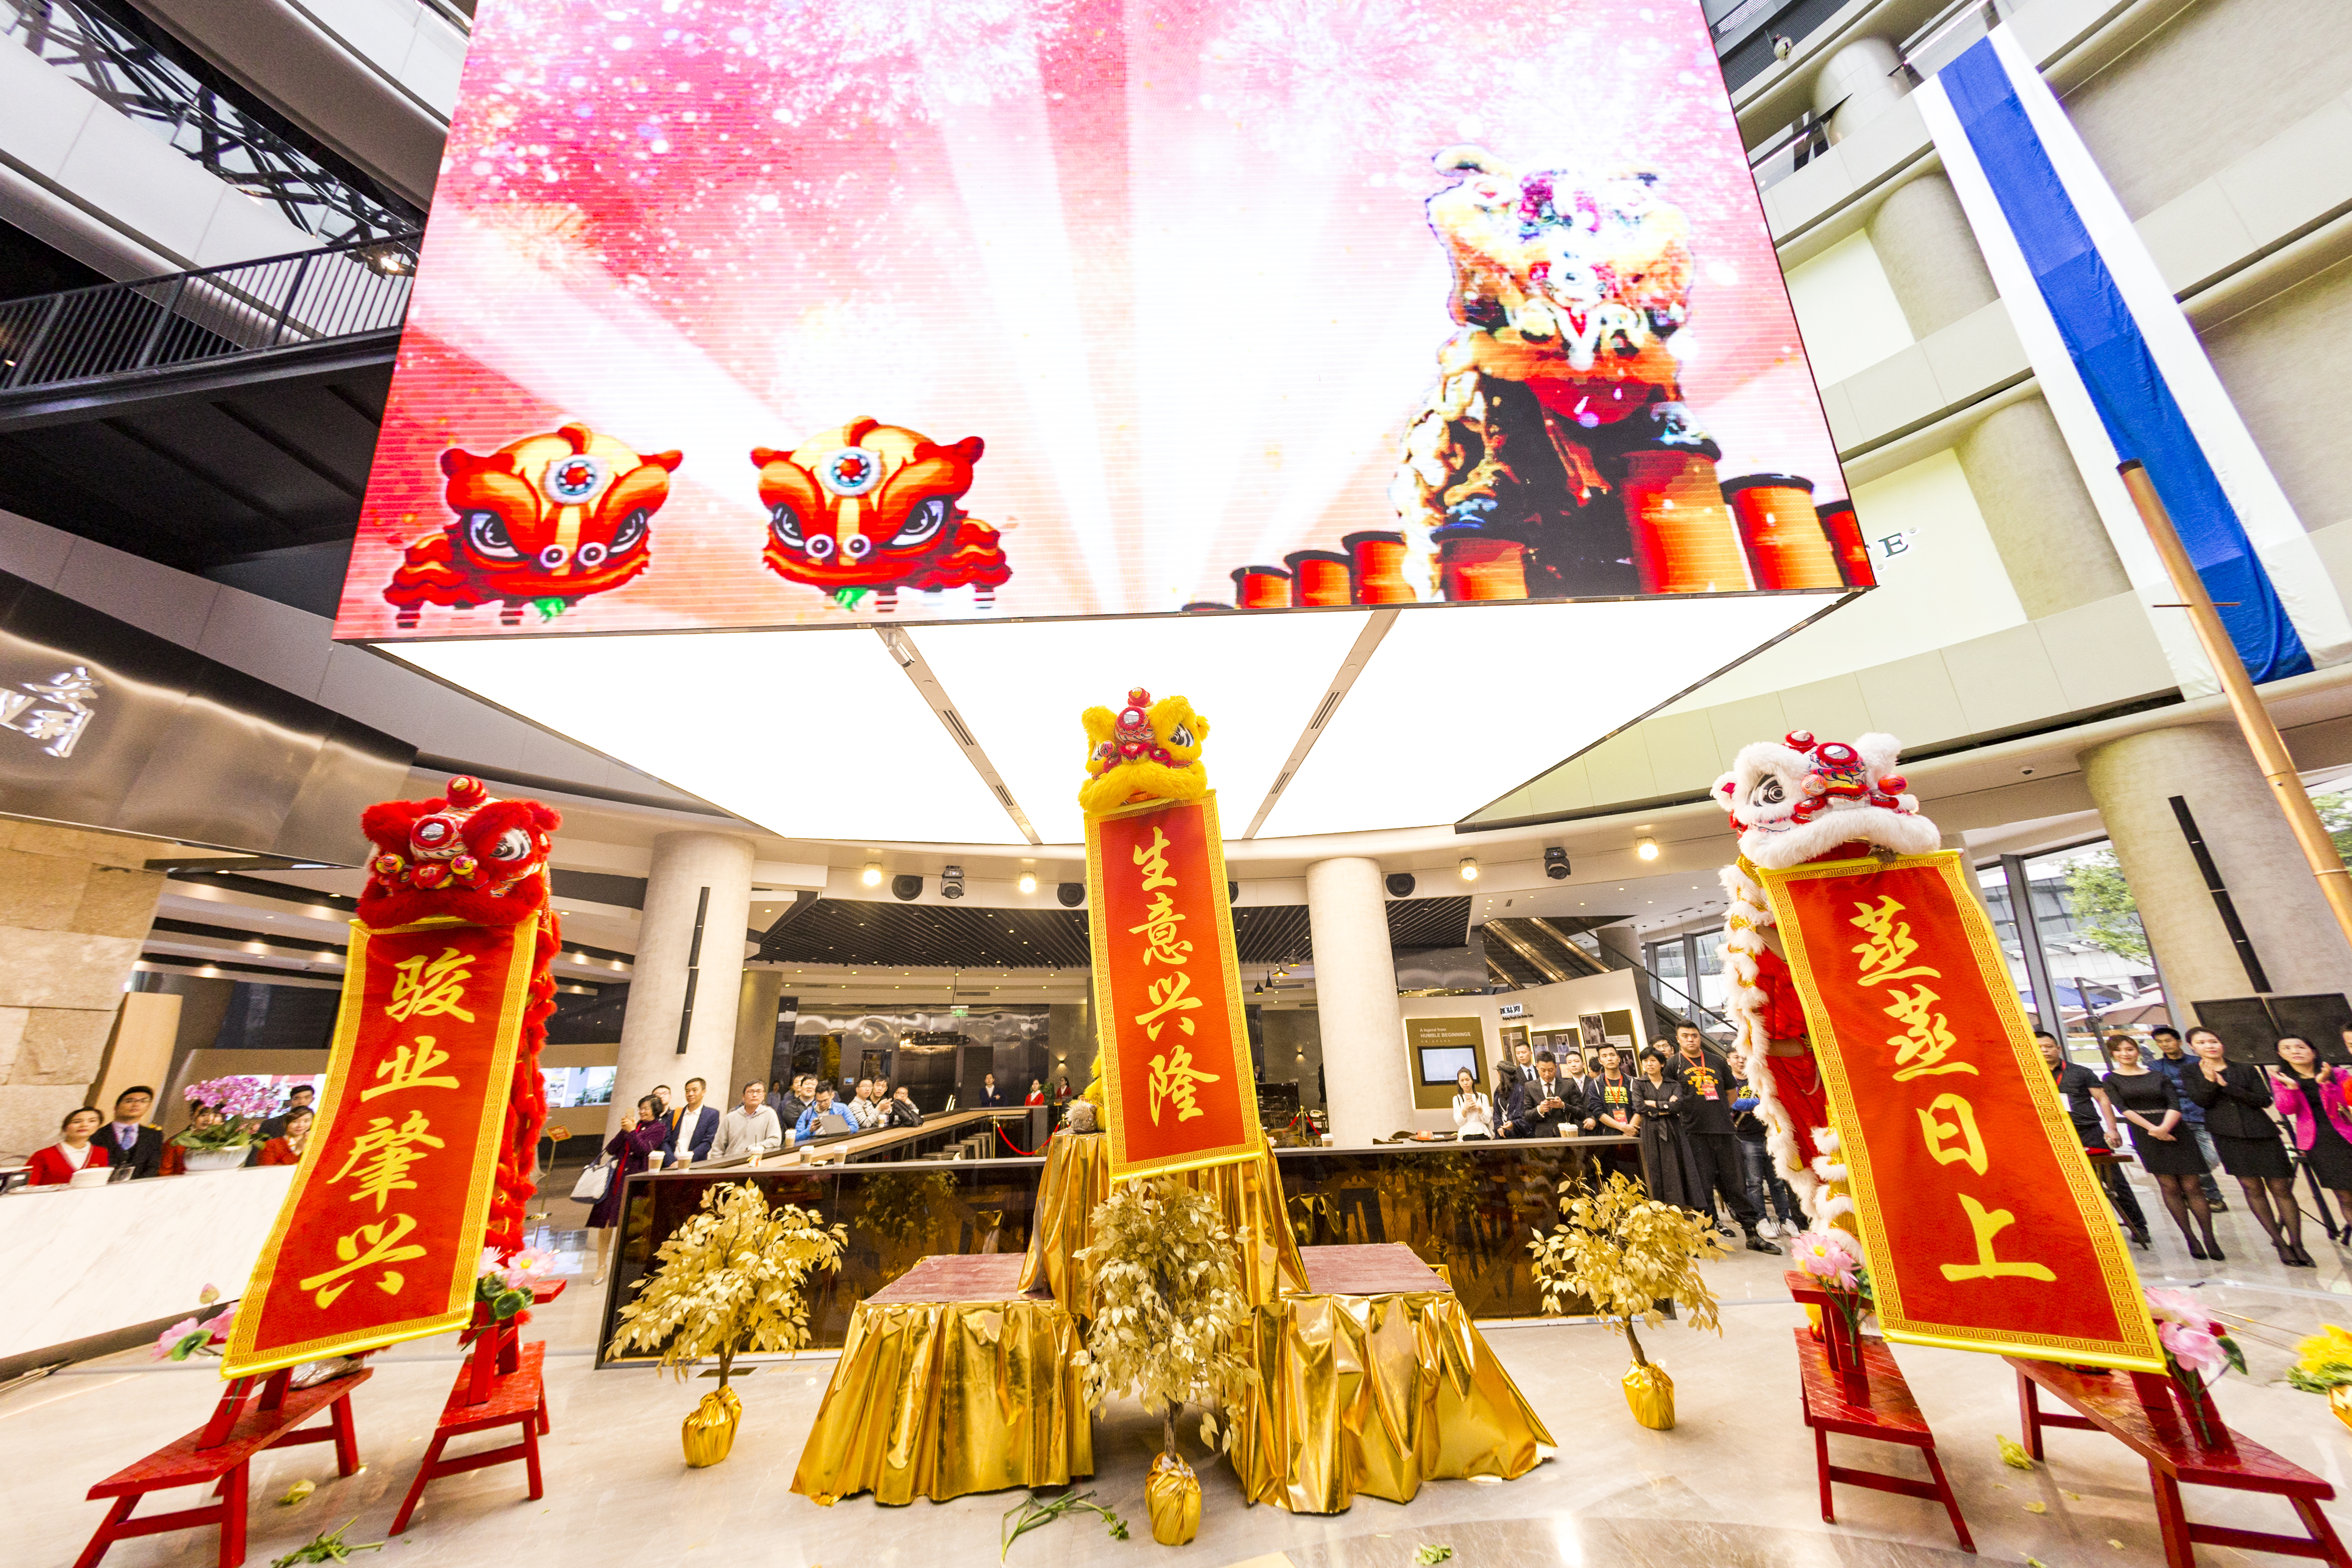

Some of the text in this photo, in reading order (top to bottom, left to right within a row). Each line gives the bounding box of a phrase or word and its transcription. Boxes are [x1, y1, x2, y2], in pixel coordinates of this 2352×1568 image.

[299, 948, 476, 1309] 骏业肇兴
[1128, 826, 1220, 1127] 生意兴隆
[1849, 894, 2057, 1282] 蒸蒸日上
